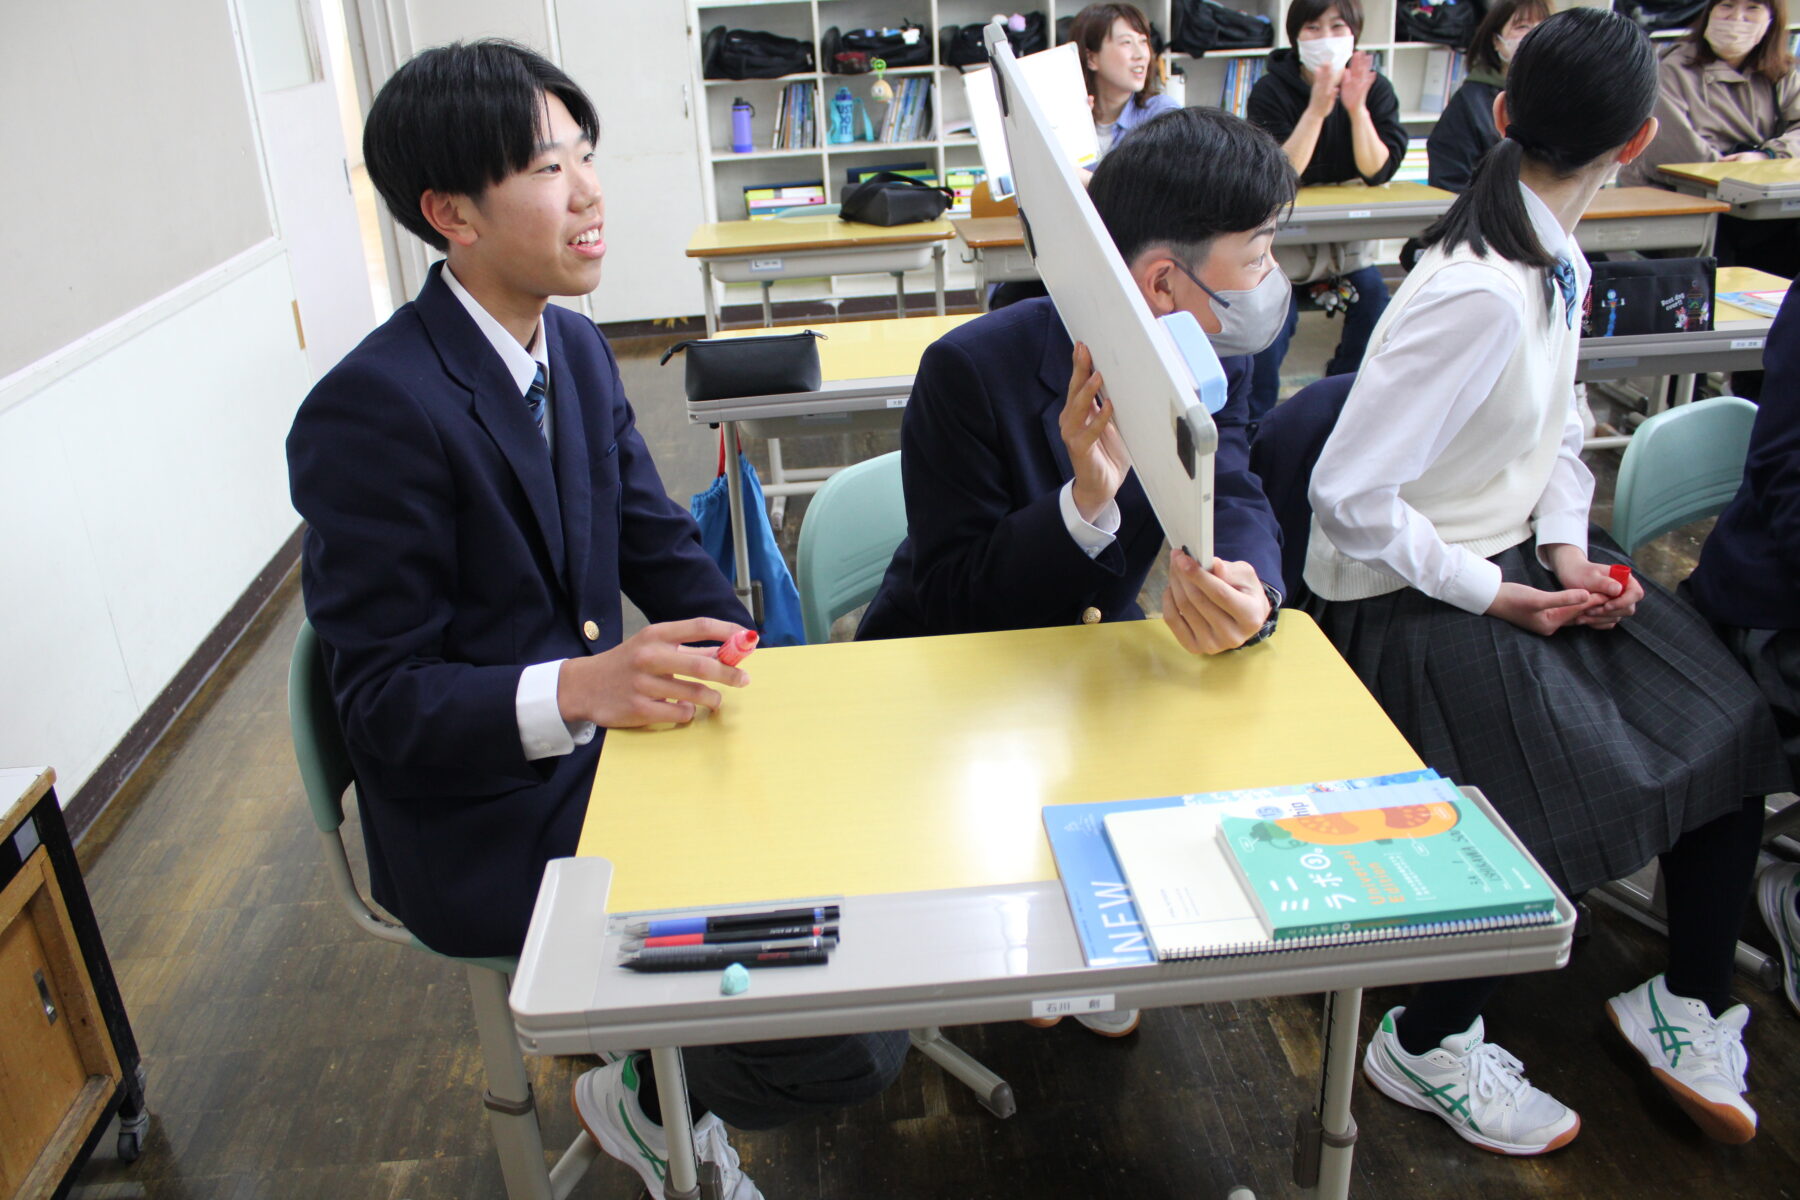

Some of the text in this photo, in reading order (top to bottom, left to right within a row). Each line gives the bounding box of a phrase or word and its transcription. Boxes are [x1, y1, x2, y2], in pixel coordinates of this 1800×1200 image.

[1269, 876, 1310, 911] ミニ
[1336, 850, 1386, 905] Universal
[1367, 861, 1405, 903] Edition
[1091, 881, 1151, 953] NEW
